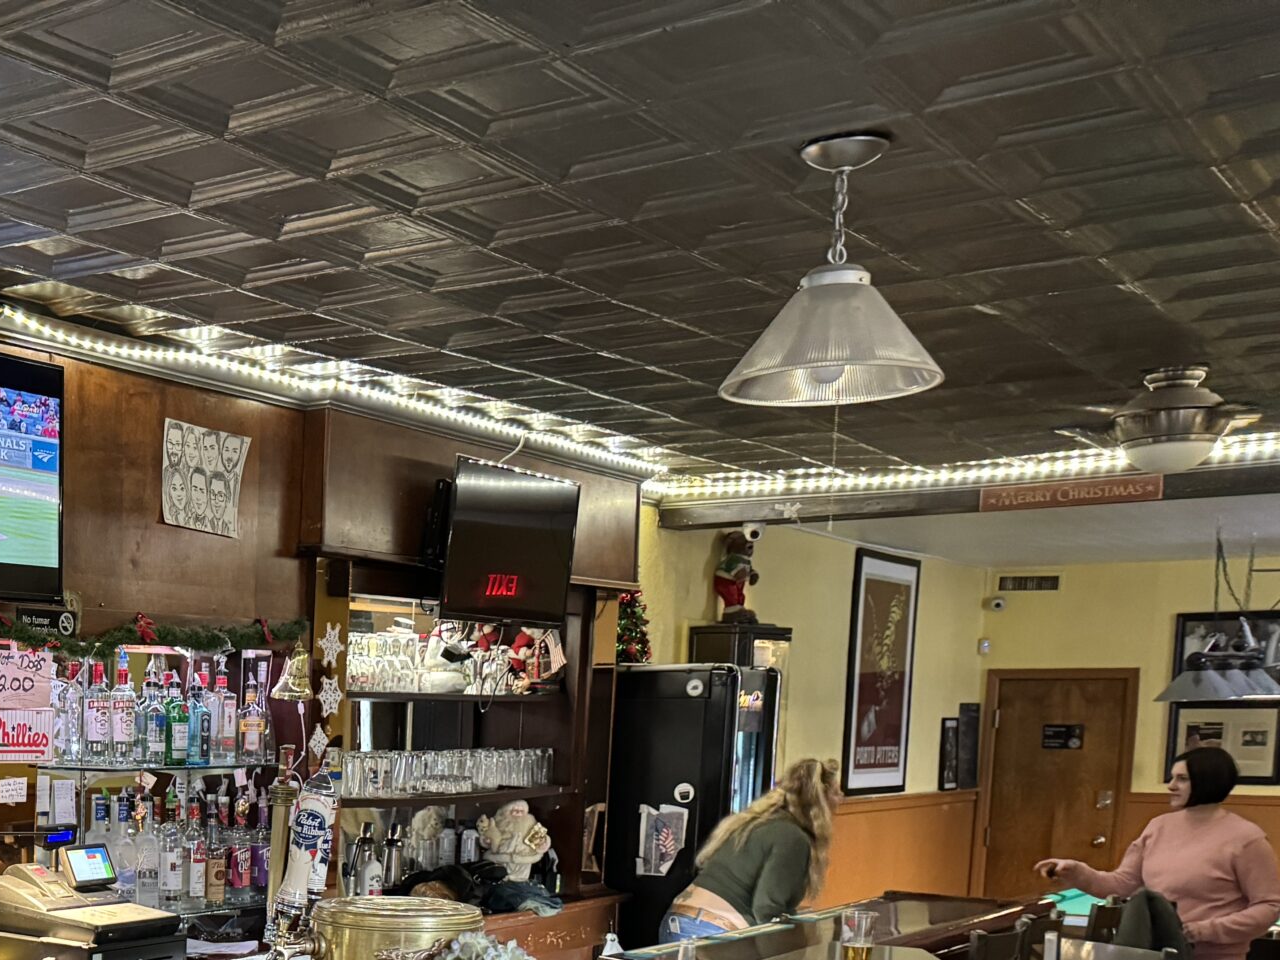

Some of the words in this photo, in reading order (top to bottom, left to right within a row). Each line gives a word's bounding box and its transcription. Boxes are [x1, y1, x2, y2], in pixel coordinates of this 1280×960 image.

[999, 490, 1053, 506] MERRY
[1057, 483, 1144, 501] CHRISTMAS
[22, 615, 31, 624] No
[32, 616, 51, 624] fumar
[297, 813, 321, 826] Pabst
